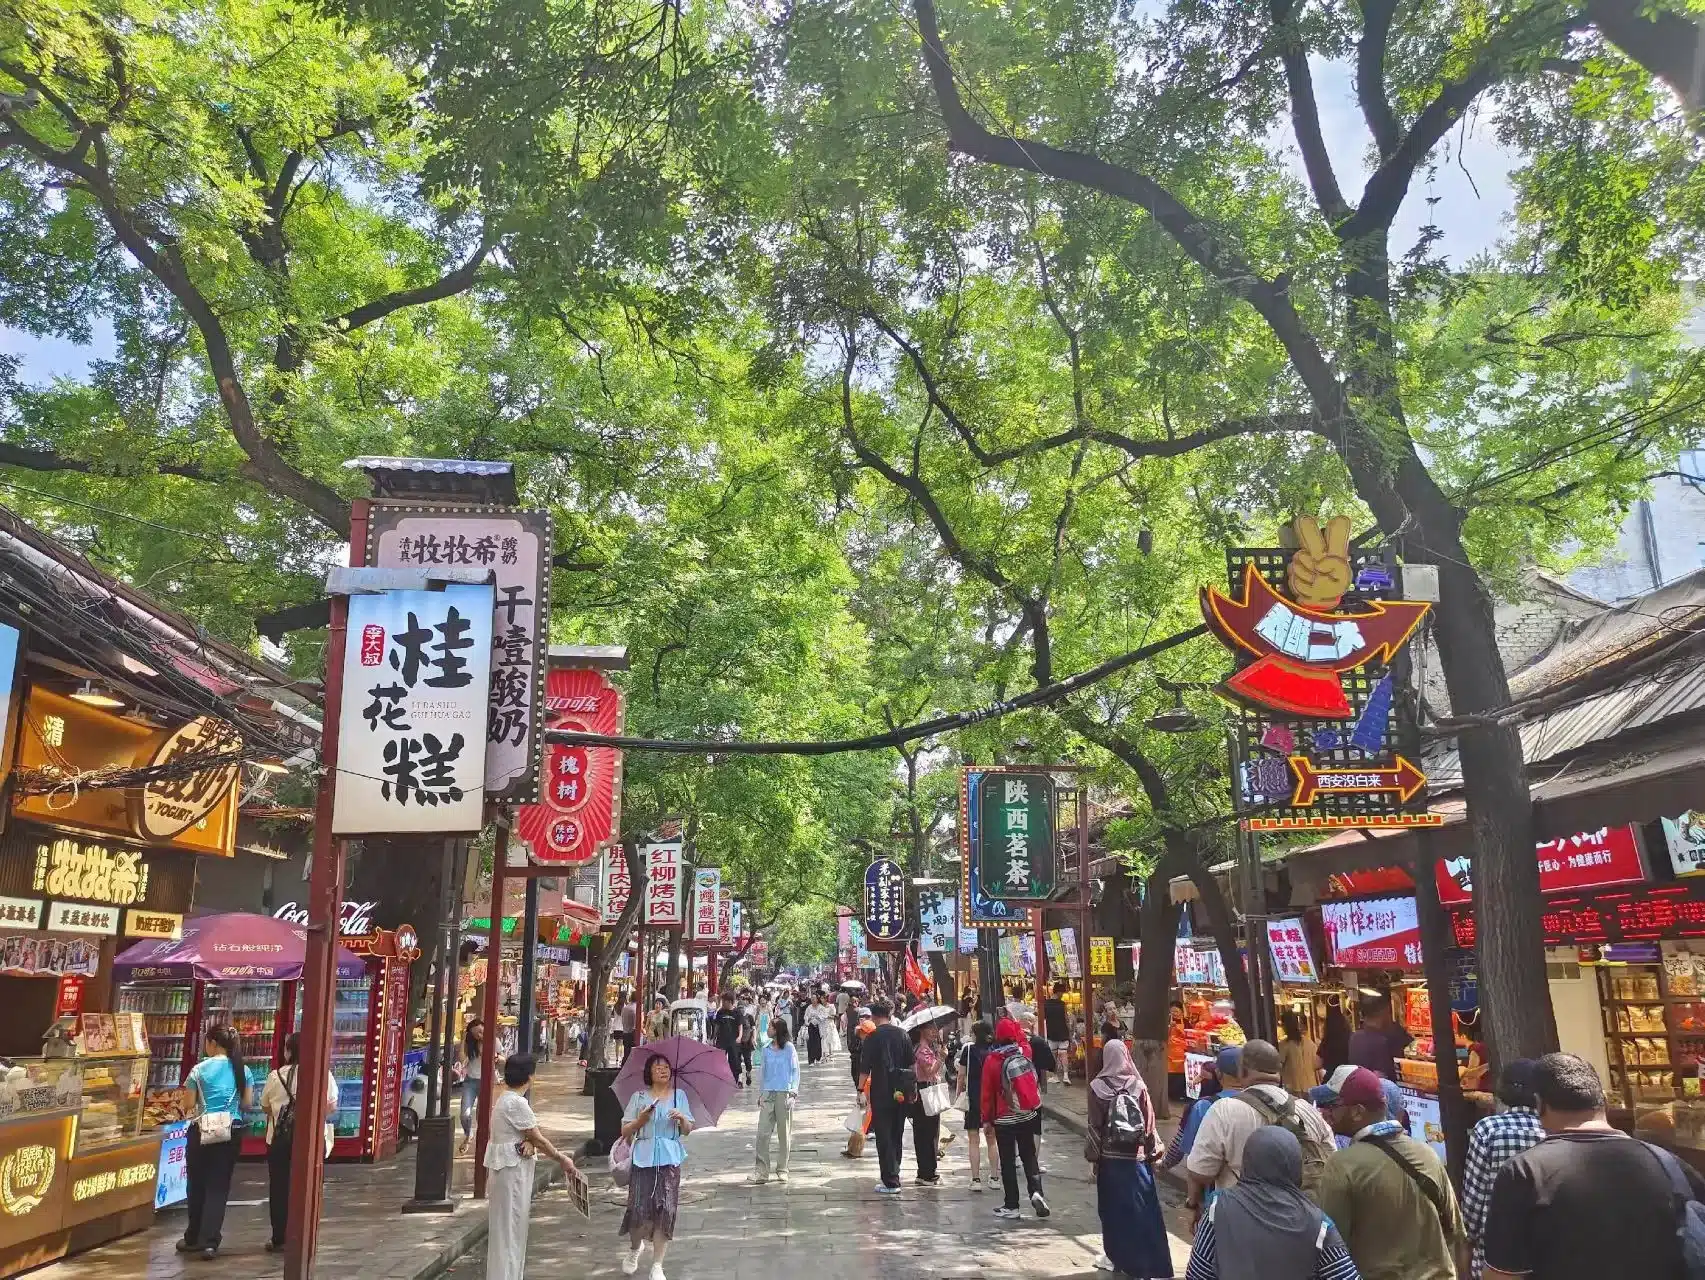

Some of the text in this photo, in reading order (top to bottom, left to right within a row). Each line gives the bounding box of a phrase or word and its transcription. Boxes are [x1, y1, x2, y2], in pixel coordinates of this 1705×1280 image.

[399, 534, 518, 566] 清真 牧牧希 酸奶
[364, 627, 384, 665] 李大叔
[362, 605, 475, 808] 桂花糕
[546, 696, 602, 713] 可口可乐
[557, 752, 580, 801] 槐树
[154, 801, 193, 822] YOGURT
[555, 824, 576, 834] 陕西
[555, 833, 575, 844] 特产
[1004, 779, 1031, 886] 陕西茗茶
[650, 849, 677, 916] 红柳烤肉
[273, 901, 378, 935] Cocola
[212, 943, 284, 953] 钻石般纯净
